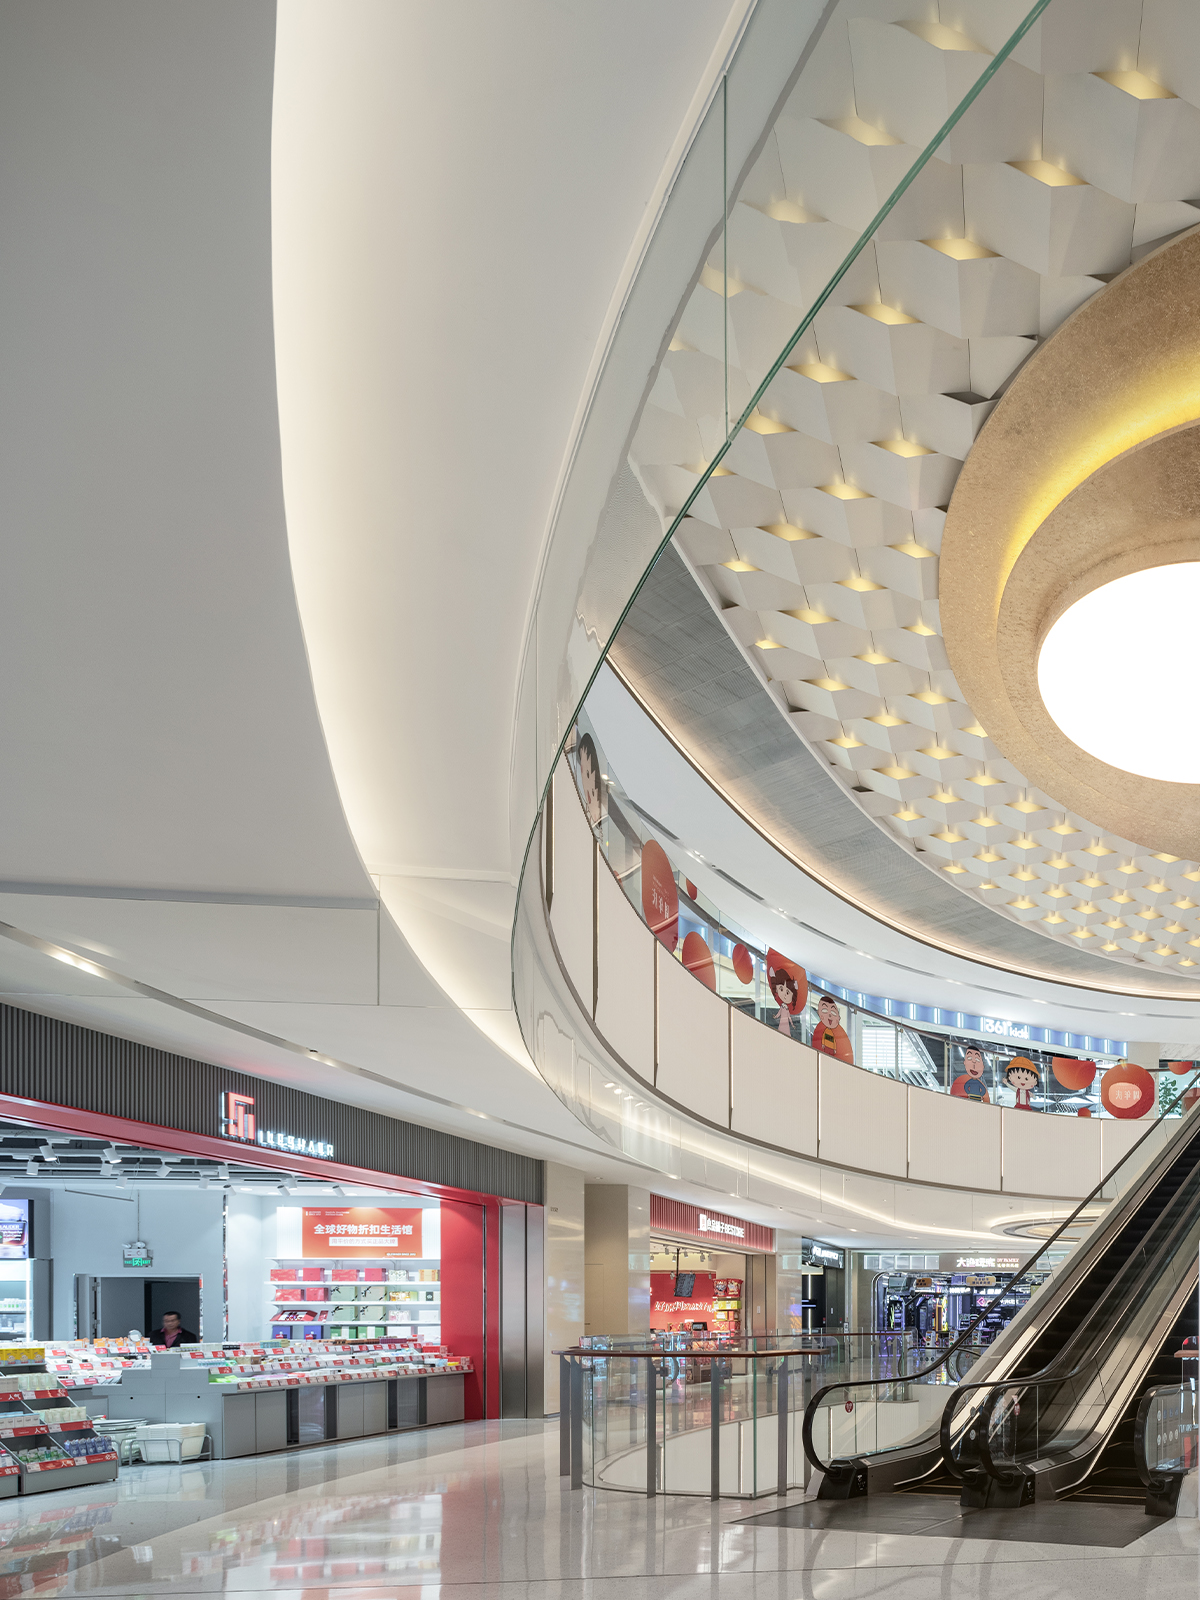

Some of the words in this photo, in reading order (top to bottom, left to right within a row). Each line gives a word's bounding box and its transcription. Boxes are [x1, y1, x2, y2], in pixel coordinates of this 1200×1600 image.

[314, 1224, 413, 1235] 全球好物折扣生活馆
